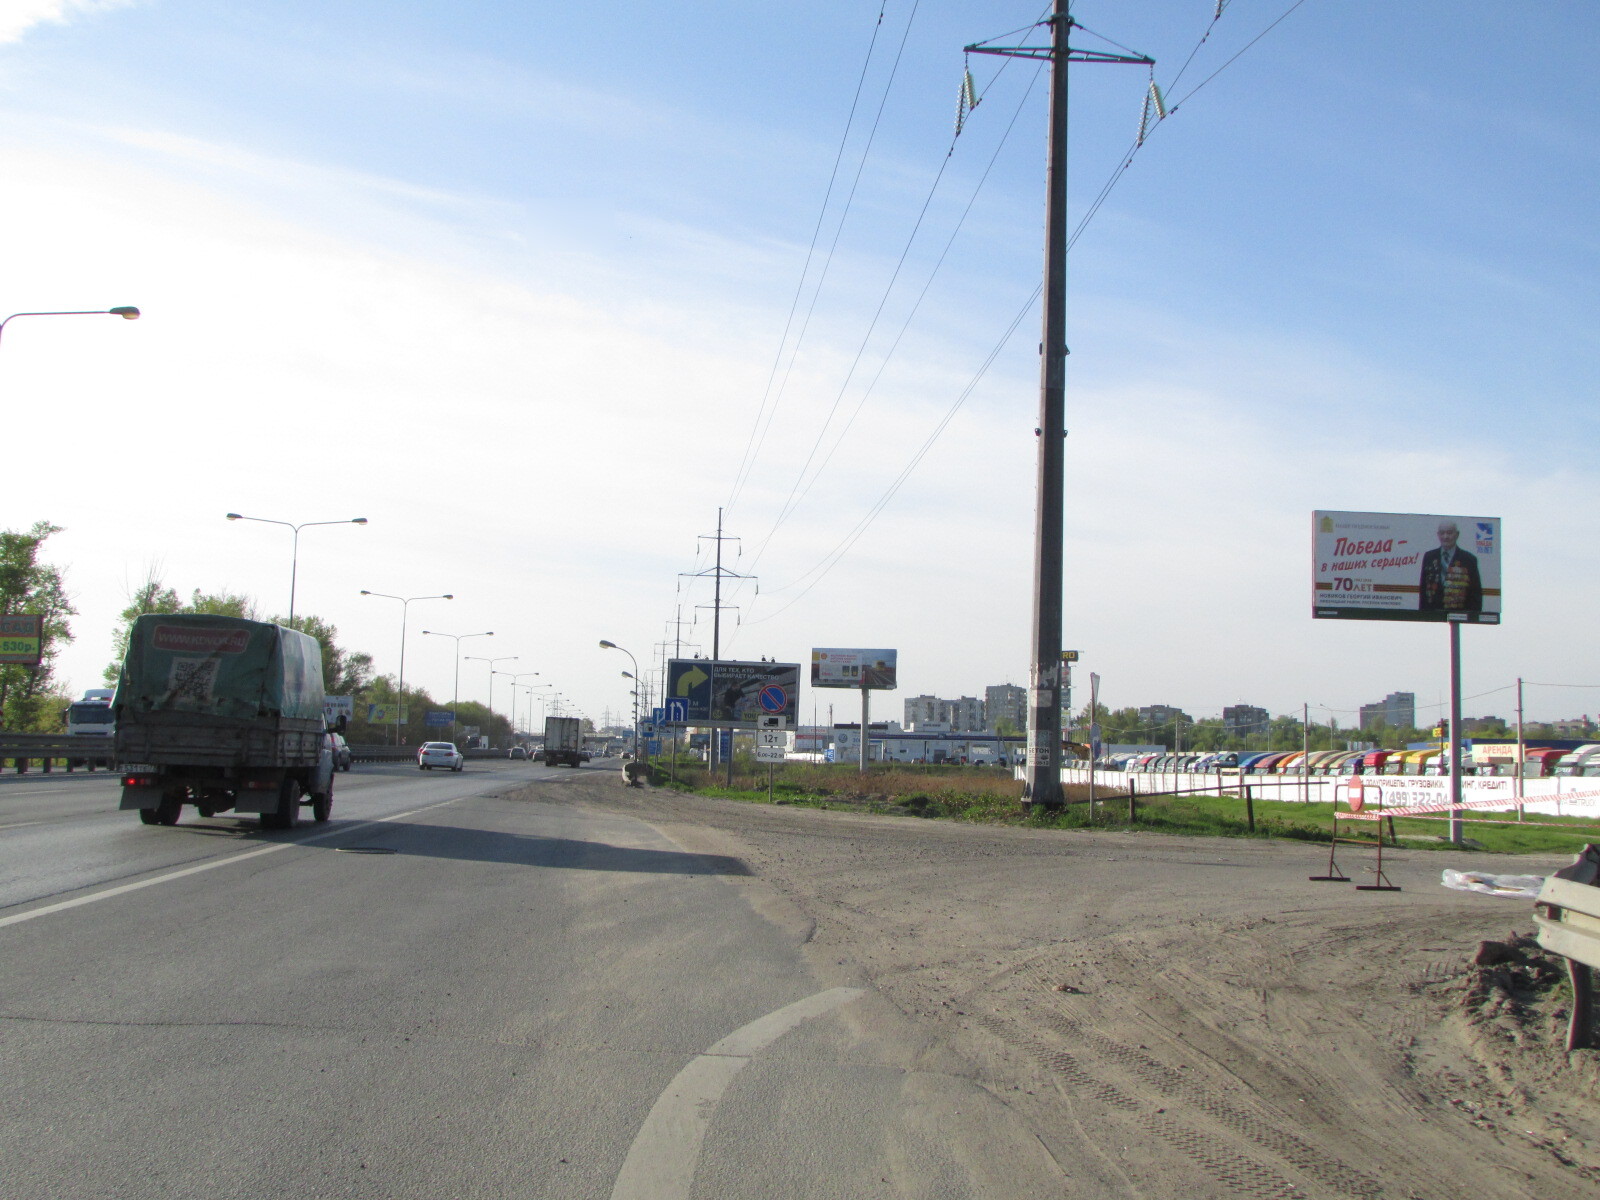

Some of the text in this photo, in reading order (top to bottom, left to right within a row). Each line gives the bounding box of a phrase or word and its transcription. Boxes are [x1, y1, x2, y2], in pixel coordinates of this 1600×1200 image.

[1333, 537, 1393, 556] Победа
[1321, 552, 1419, 572] в наших сердцах!
[1334, 578, 1353, 591] 70
[1353, 583, 1373, 592] ЛЕТ
[713, 672, 747, 680] ВЫБИРАЕТ
[1482, 745, 1513, 755] АРЕНДА
[1478, 780, 1507, 790] КРЕДИТ!
